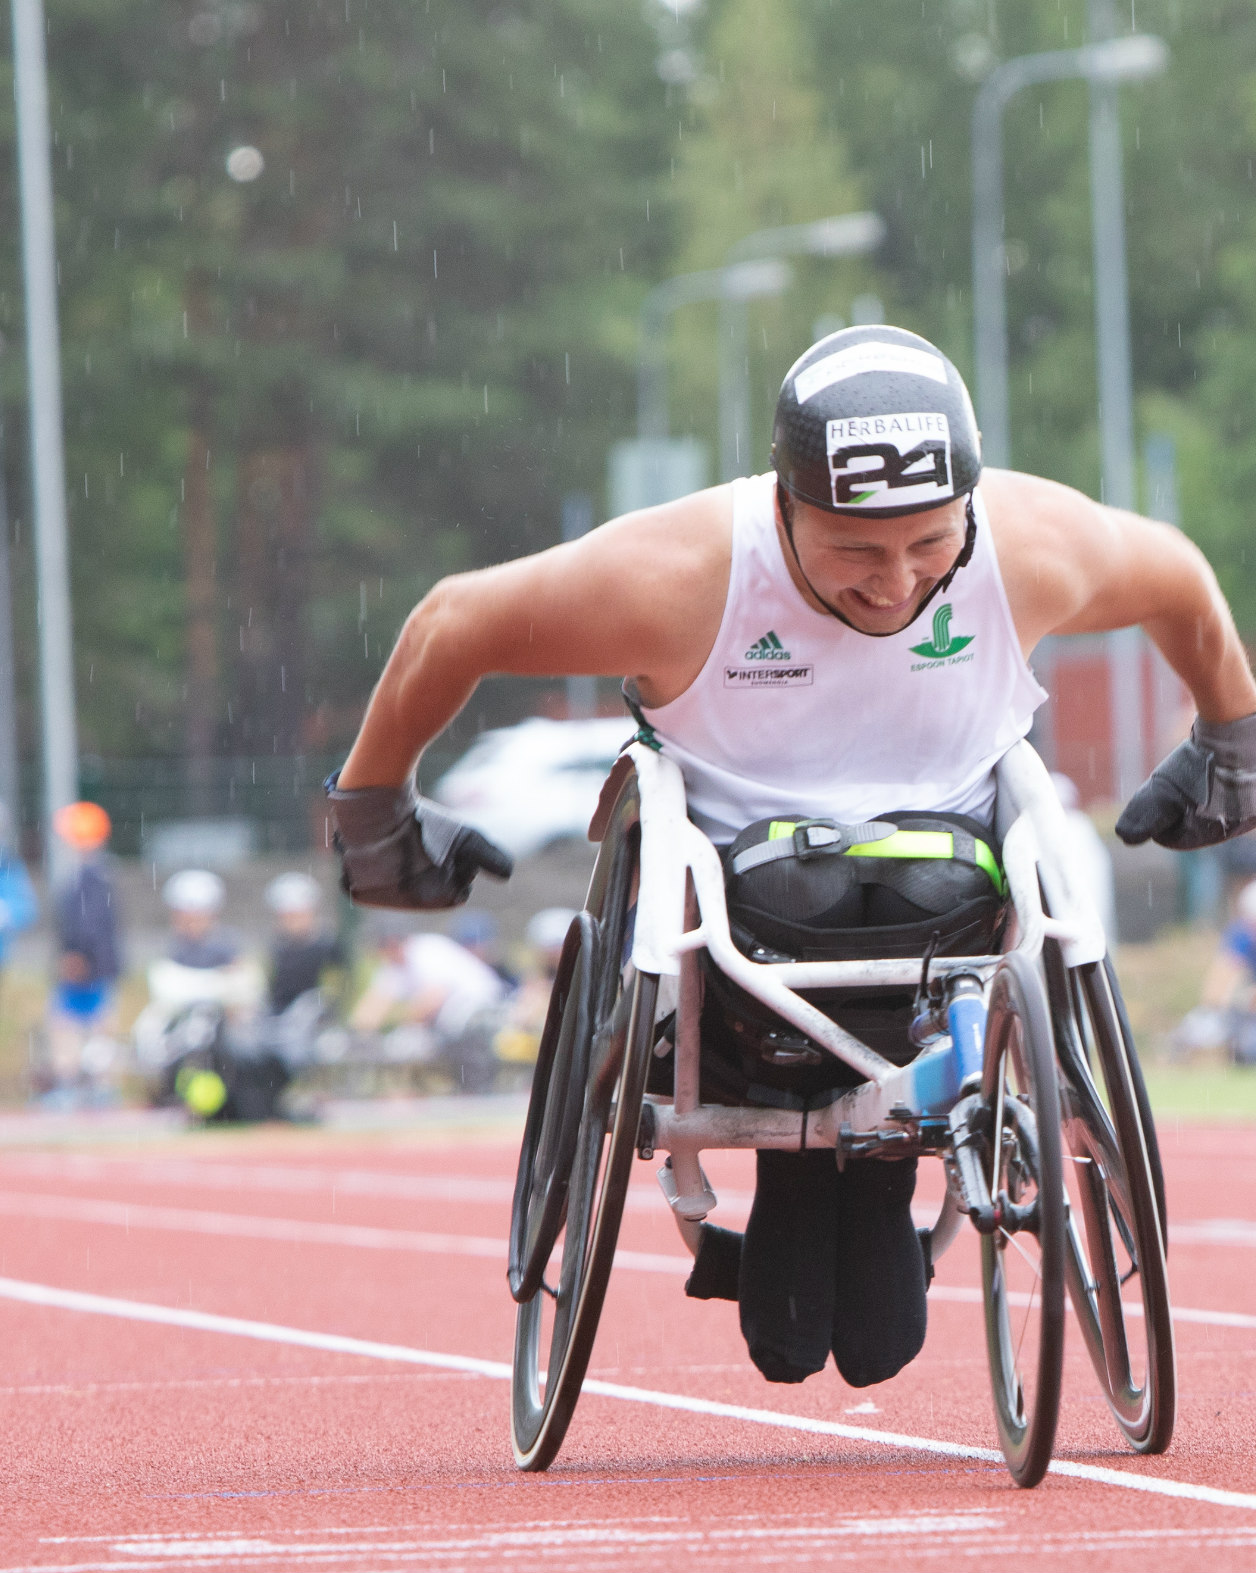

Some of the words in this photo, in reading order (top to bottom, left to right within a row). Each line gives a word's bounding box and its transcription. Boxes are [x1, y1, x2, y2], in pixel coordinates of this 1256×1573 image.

[831, 416, 946, 439] HERBALIFE
[831, 440, 949, 504] 24
[744, 648, 791, 661] adidas
[739, 667, 810, 680] INTERSPORT
